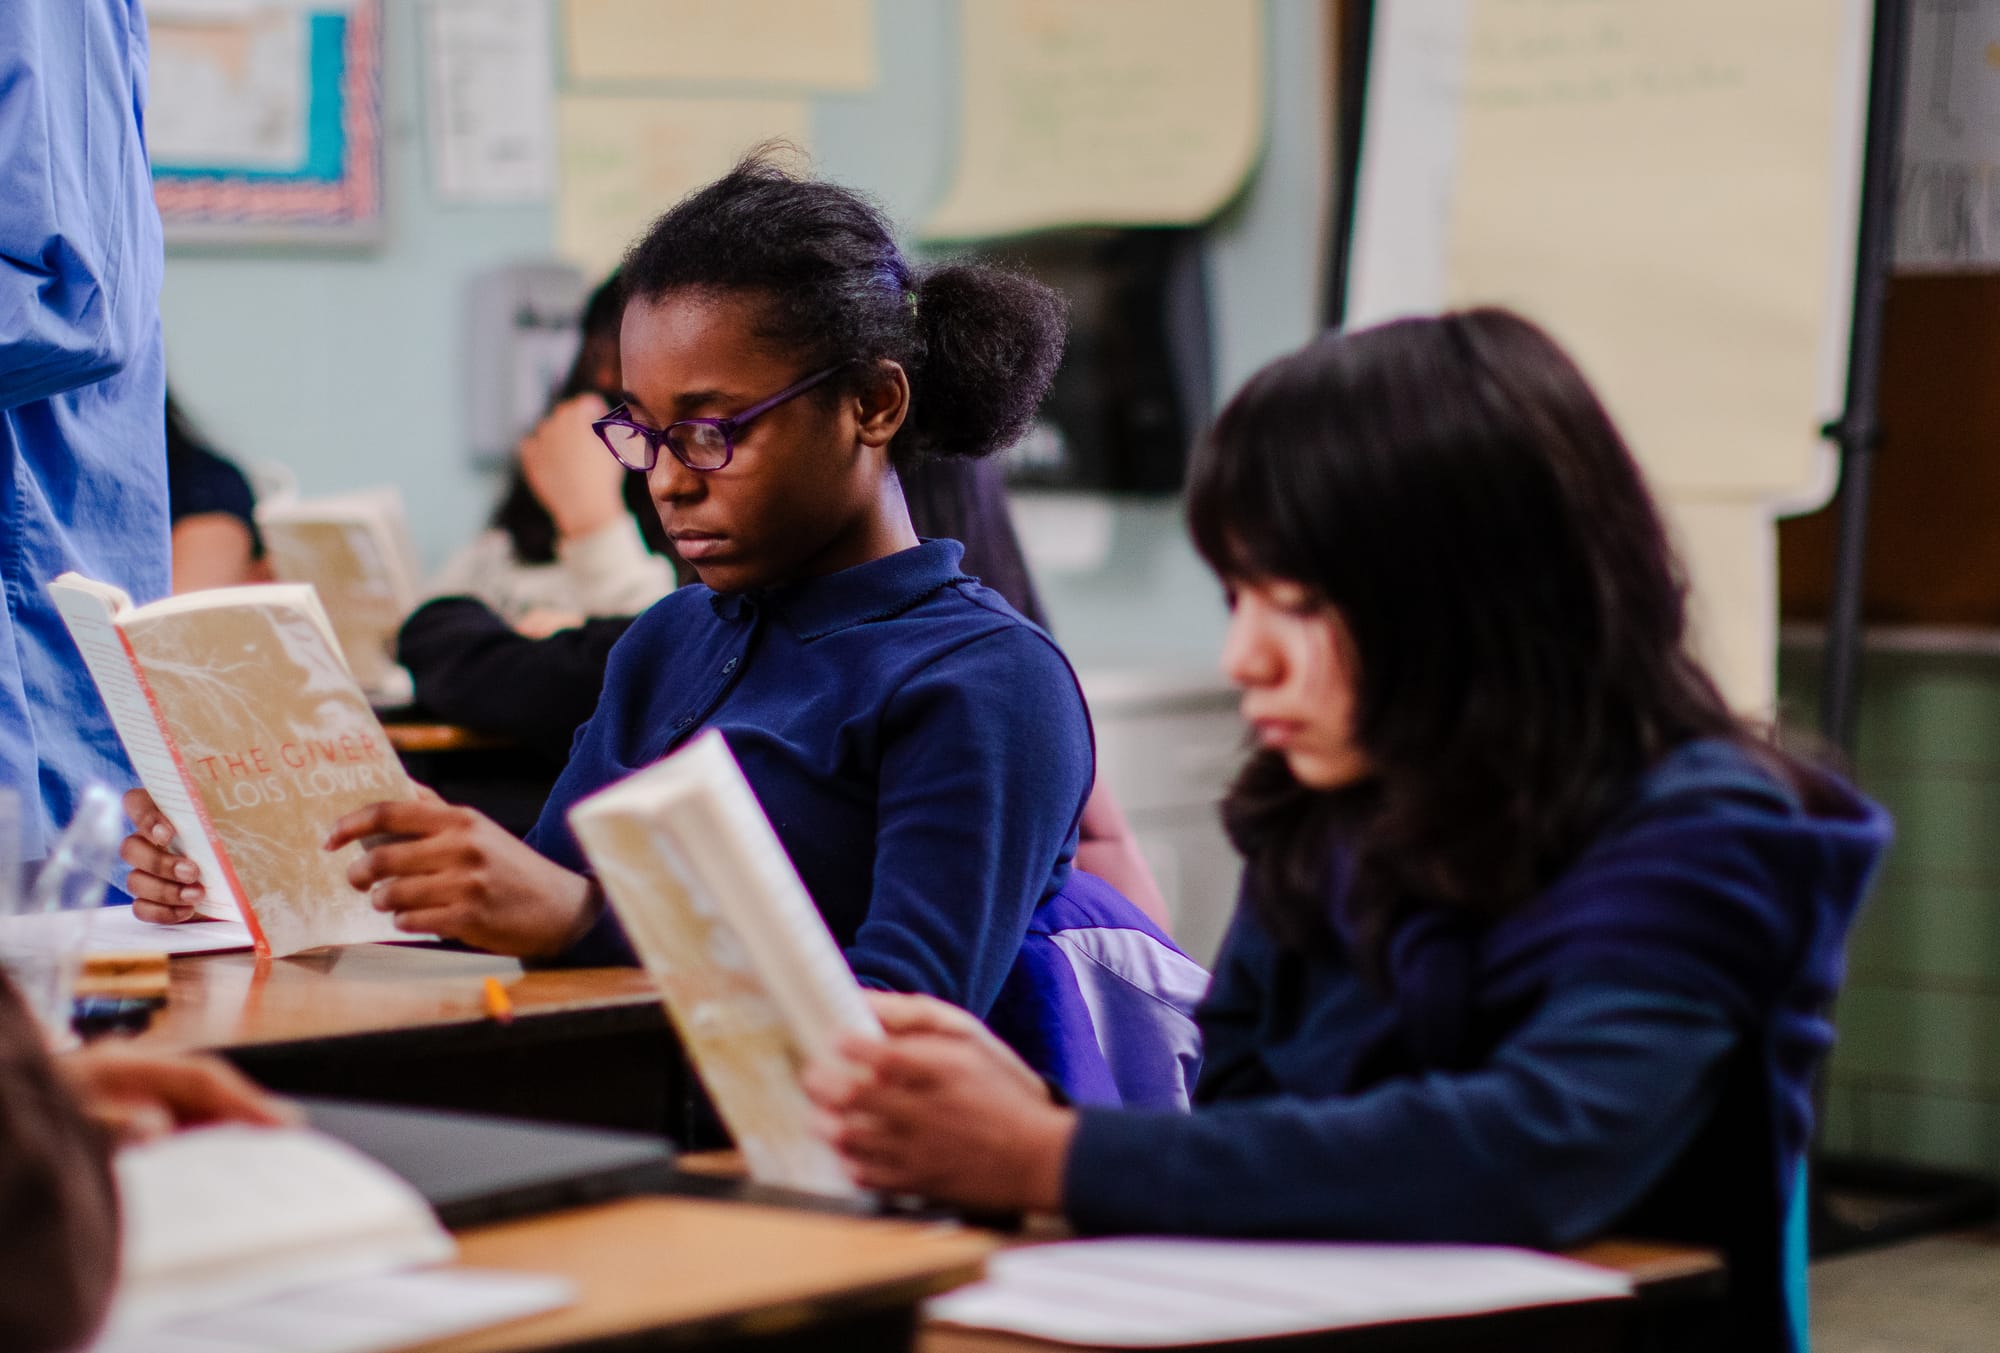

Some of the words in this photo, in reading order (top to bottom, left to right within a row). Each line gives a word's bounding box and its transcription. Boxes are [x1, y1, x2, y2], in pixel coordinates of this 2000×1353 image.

[197, 746, 272, 781] THE
[280, 733, 386, 769] GIVER
[216, 775, 287, 811] LOIS
[292, 764, 395, 797] LOWRY
